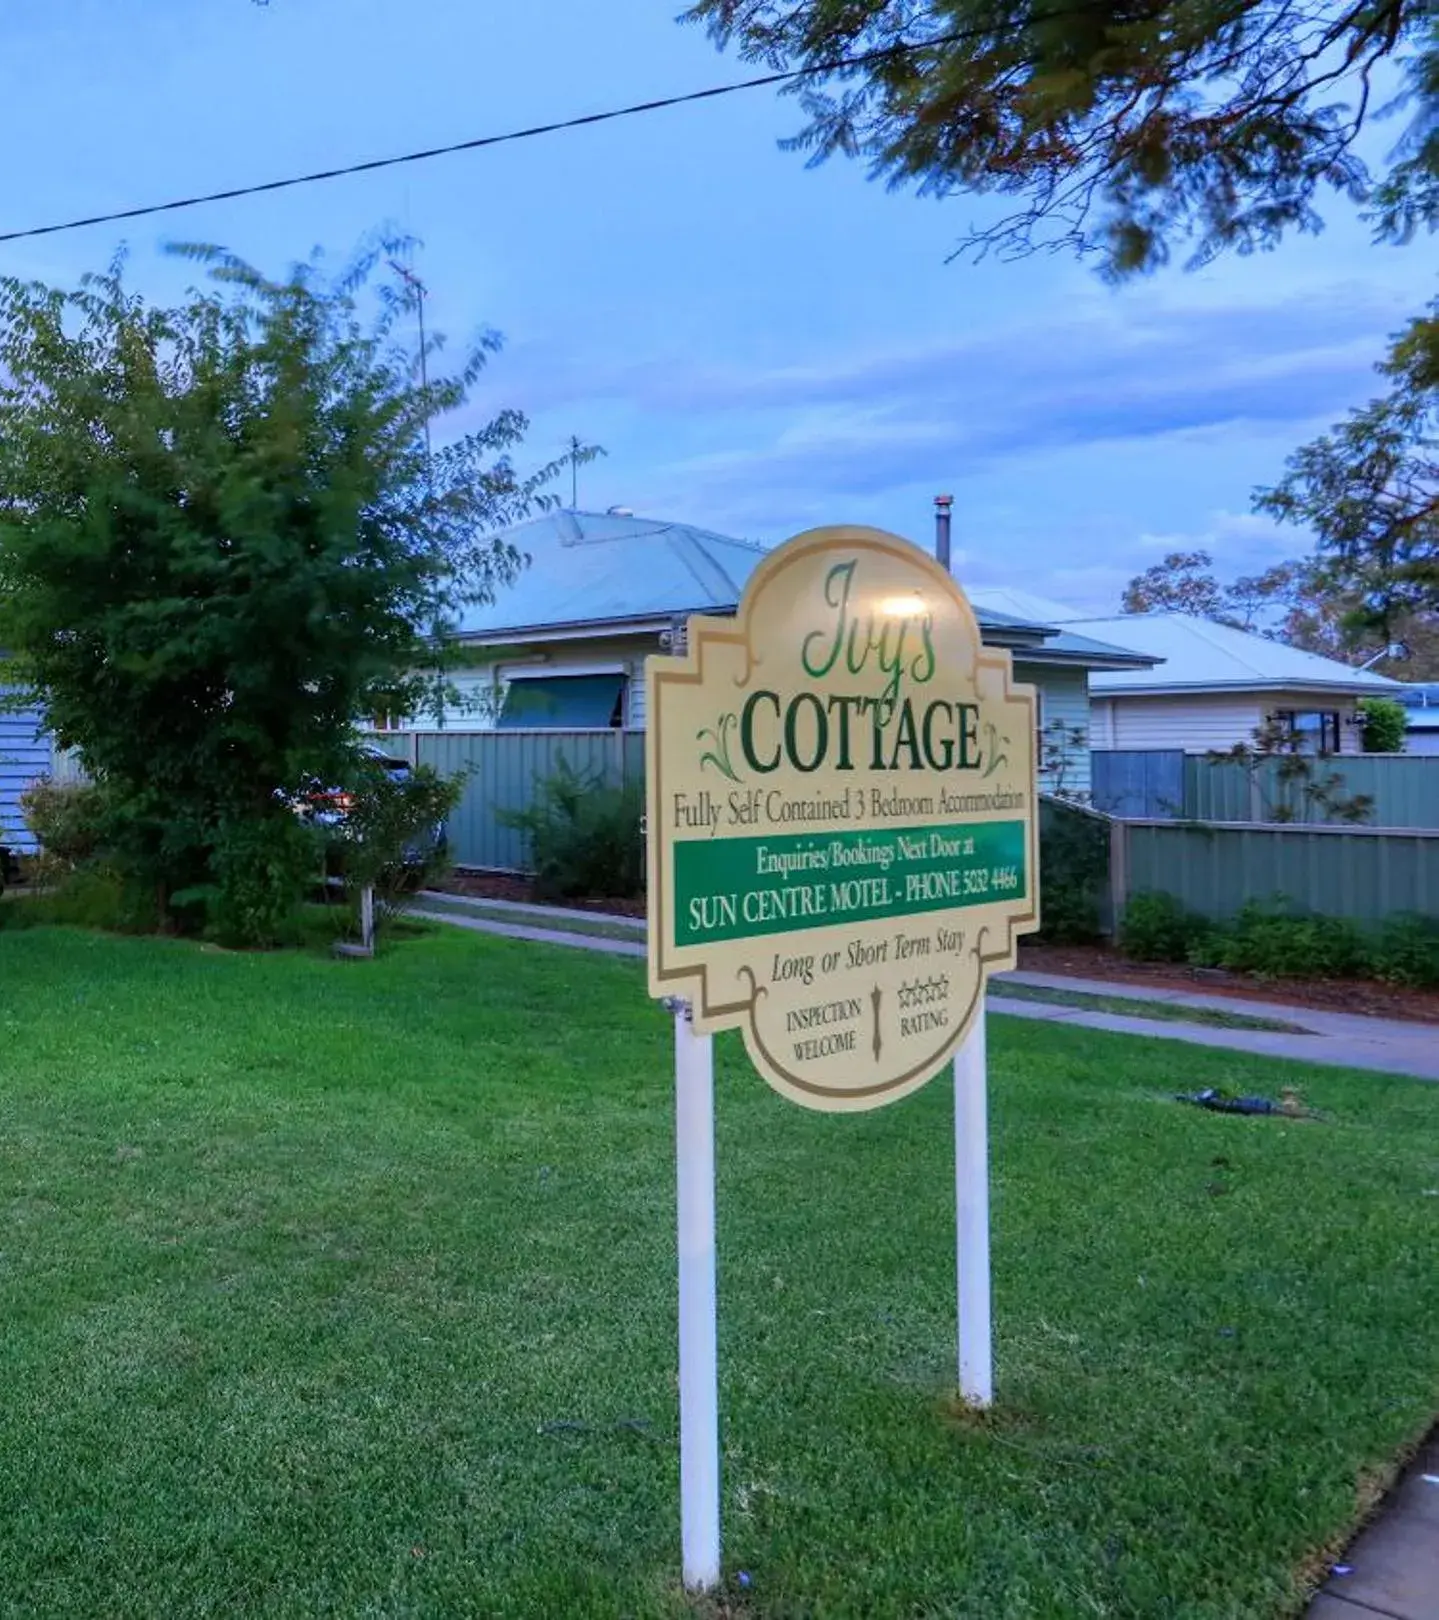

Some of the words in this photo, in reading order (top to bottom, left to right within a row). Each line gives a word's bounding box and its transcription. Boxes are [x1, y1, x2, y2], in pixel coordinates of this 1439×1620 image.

[740, 690, 983, 773] COTTAGE
[673, 791, 721, 837] Fully
[728, 788, 763, 825] Self
[766, 786, 851, 823] Contained
[856, 789, 865, 820] 3
[870, 786, 933, 817] Bedroom
[756, 837, 894, 880] Enquiries/Bookings
[897, 836, 927, 861] Next
[930, 833, 960, 858] Door
[963, 837, 974, 855] at
[689, 893, 737, 930] SUN
[743, 884, 827, 922] CENTRE
[830, 878, 892, 912] MOTEL
[906, 871, 960, 901] PHONE
[963, 868, 988, 895] 5032
[991, 865, 1018, 891] 4466
[771, 953, 814, 985] Long
[821, 952, 841, 973] or
[846, 940, 889, 970] Short
[895, 934, 931, 960] Term
[936, 928, 966, 957] Stay
[786, 998, 862, 1033] INSPECTION
[900, 1008, 949, 1037] RATING
[793, 1030, 857, 1062] WELCOME
